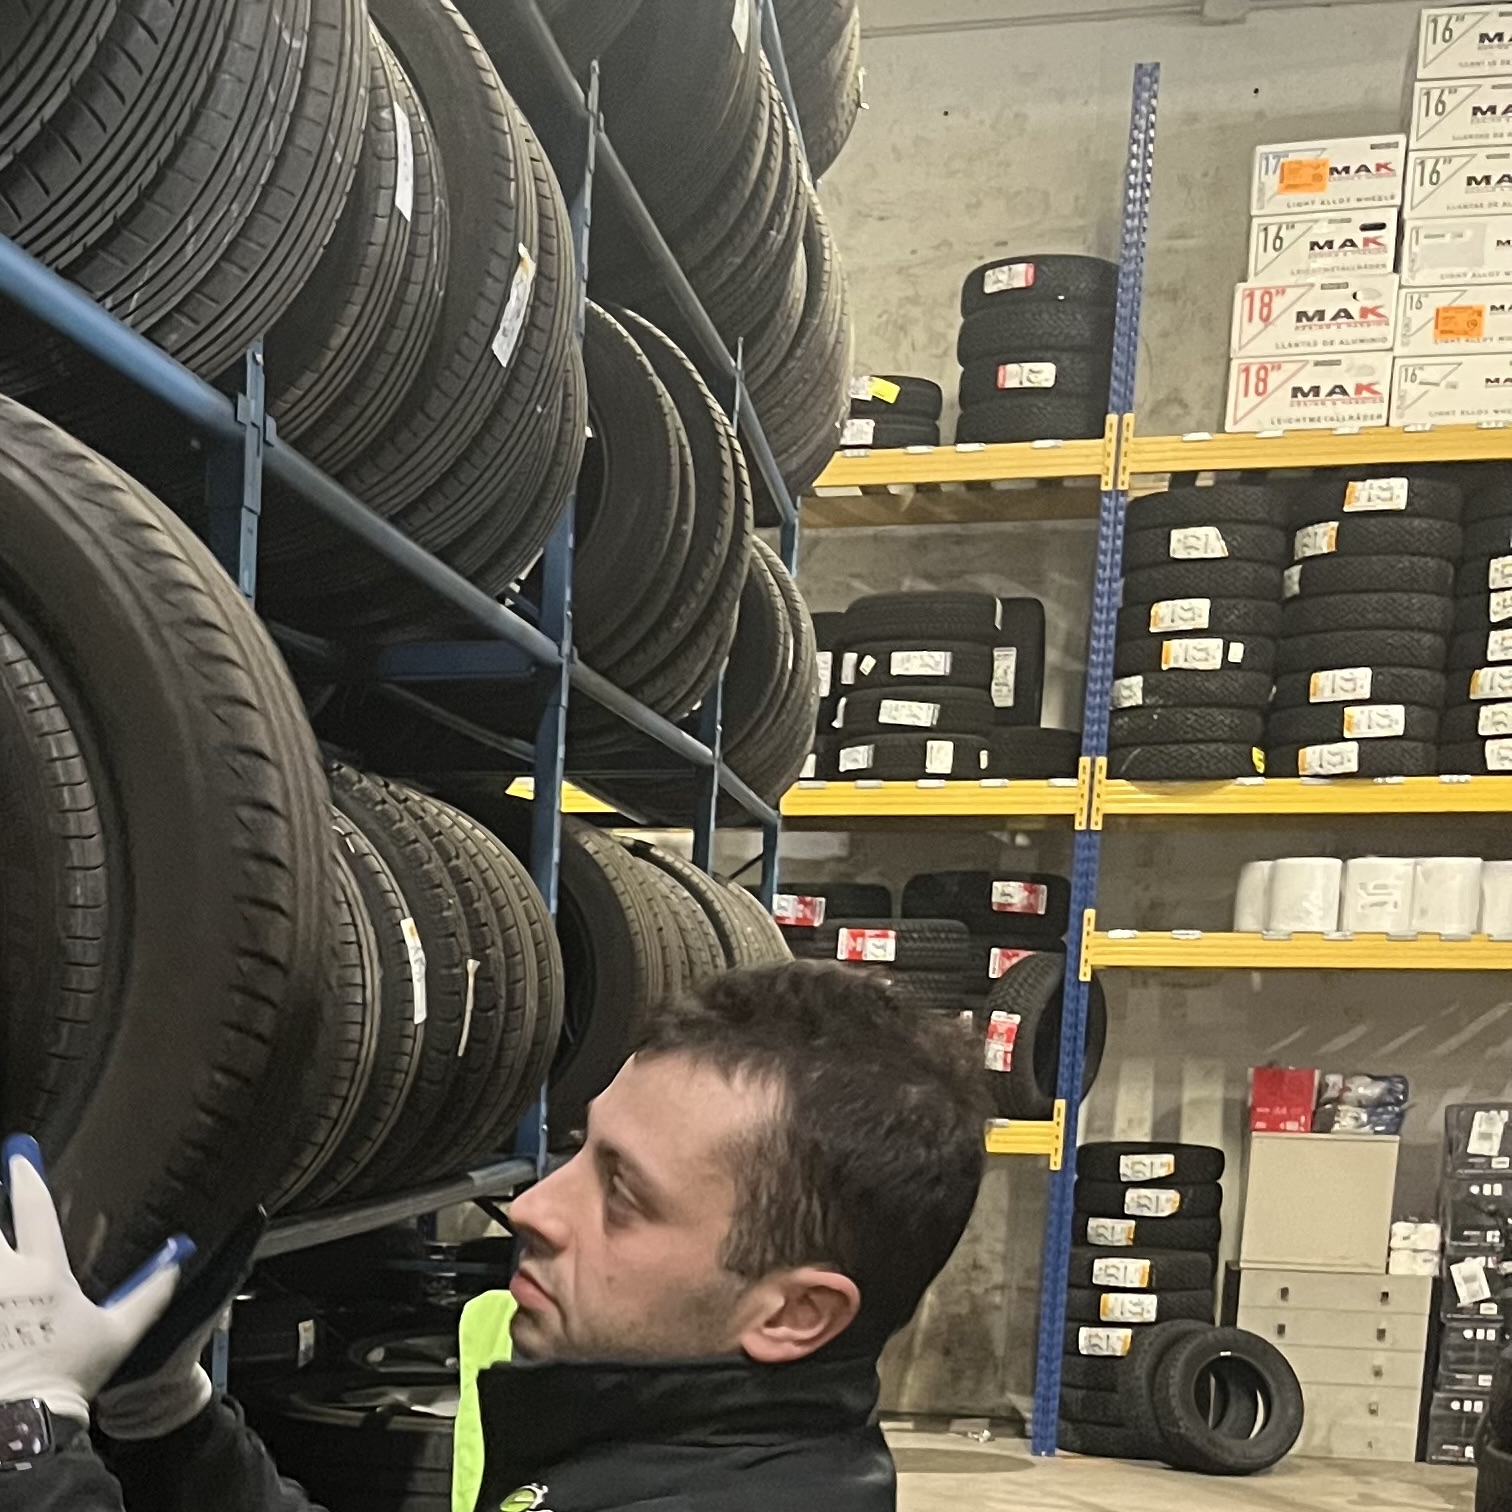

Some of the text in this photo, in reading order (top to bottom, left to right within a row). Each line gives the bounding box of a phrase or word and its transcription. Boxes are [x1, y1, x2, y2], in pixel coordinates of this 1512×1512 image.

[1329, 162, 1396, 175] MAK
[1466, 174, 1512, 187] MA
[1309, 236, 1386, 252] MAK
[1296, 305, 1388, 323] MAK
[1291, 381, 1384, 399] MAK
